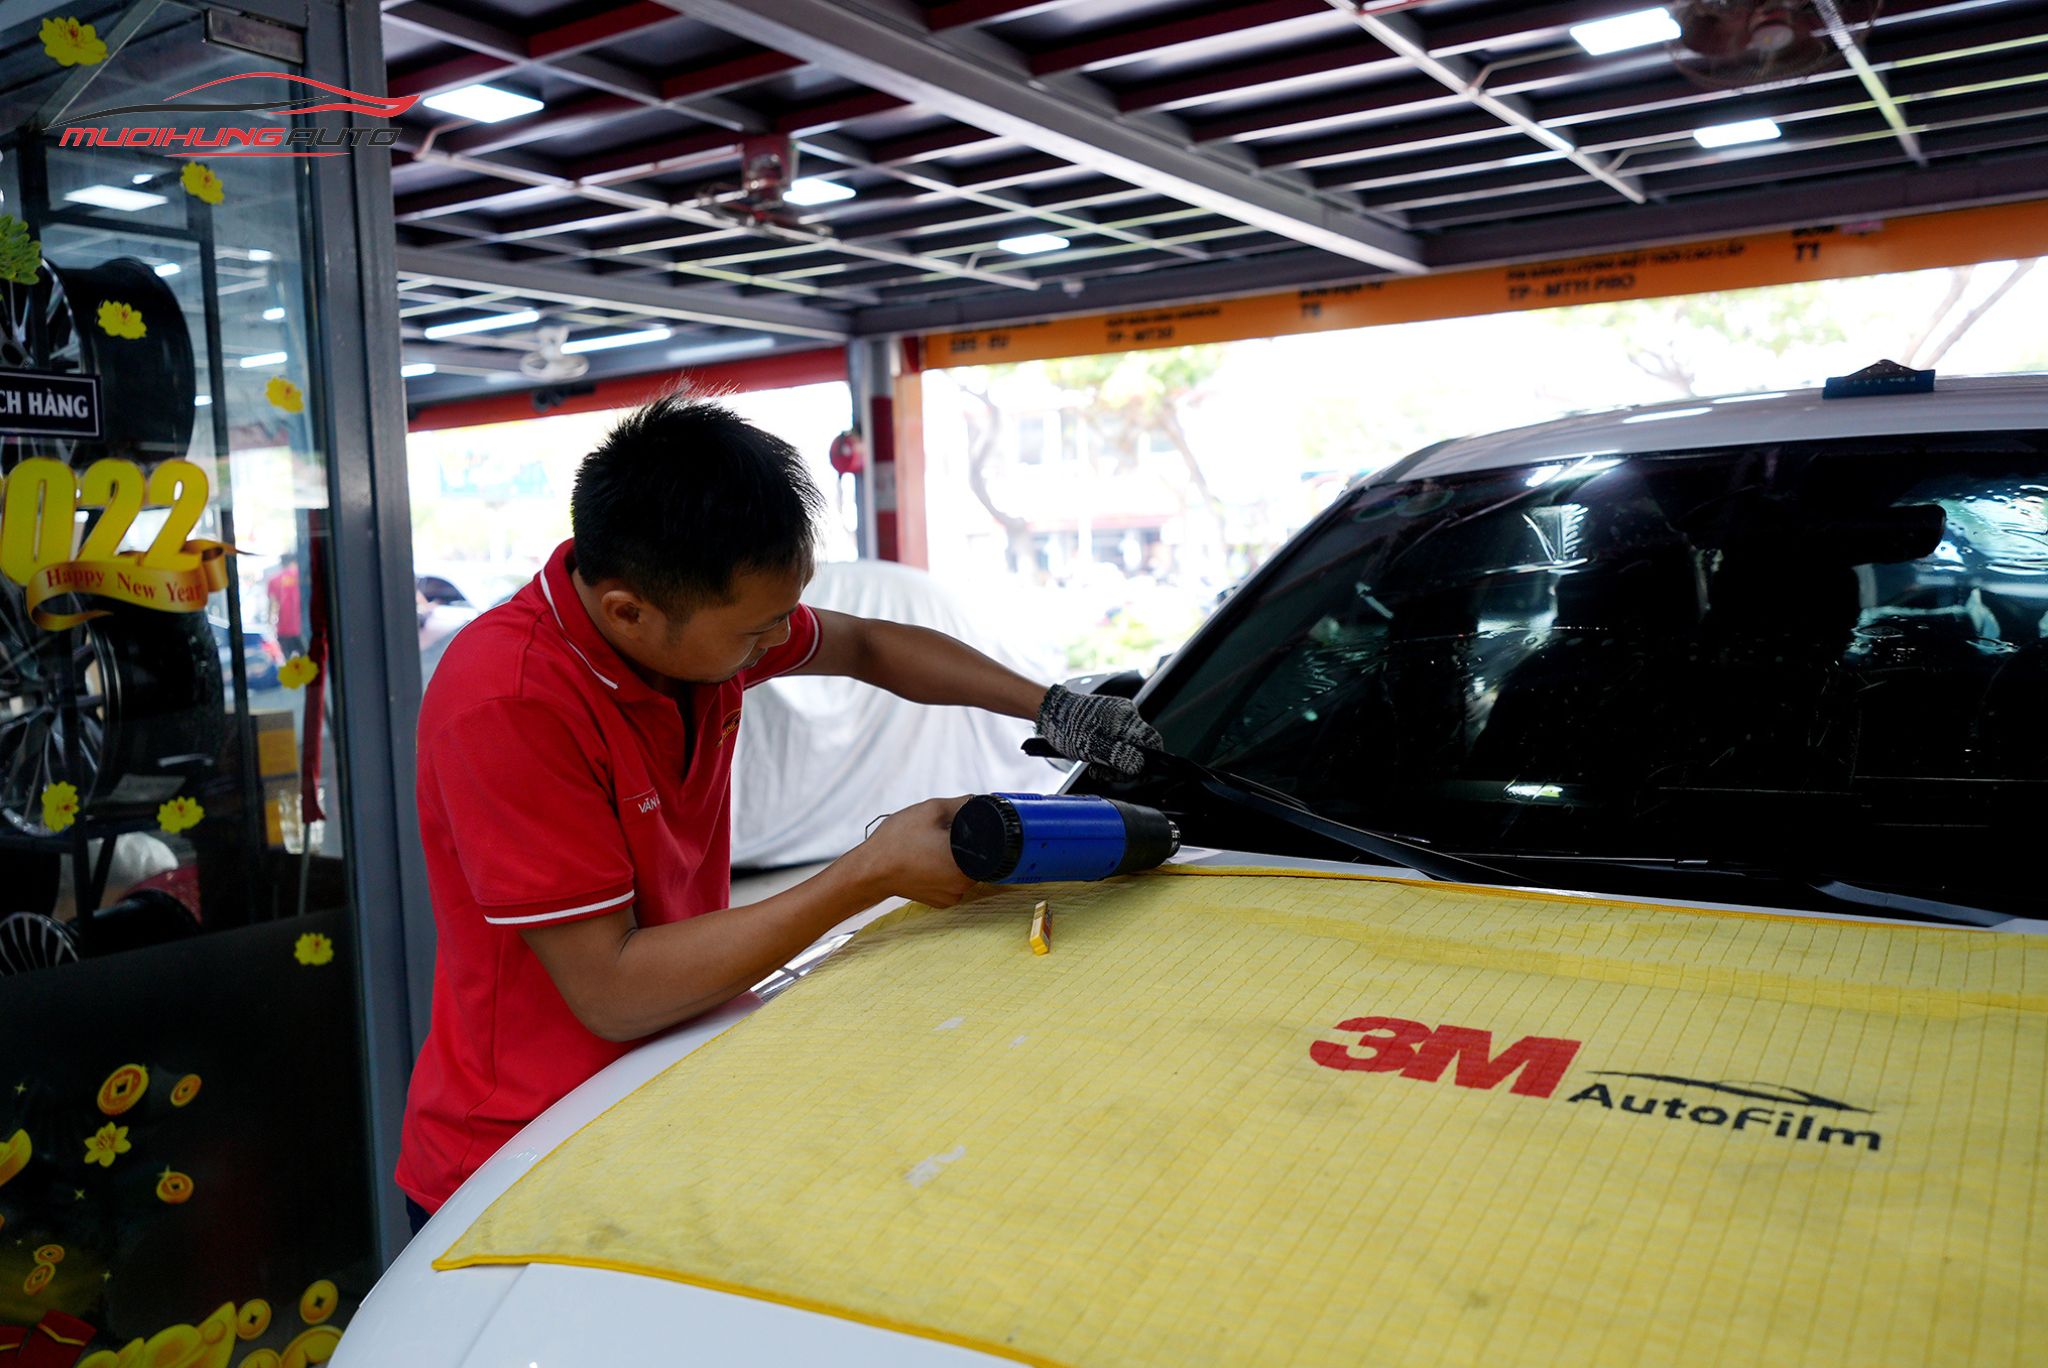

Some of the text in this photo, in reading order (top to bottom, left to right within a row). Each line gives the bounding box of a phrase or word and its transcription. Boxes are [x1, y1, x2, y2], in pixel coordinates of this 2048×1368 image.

[27, 387, 89, 419] HÀNG
[0, 456, 209, 588] 022
[46, 566, 204, 604] Happy New Year
[1309, 1016, 1582, 1099] 3M
[1567, 1082, 1882, 1152] AutoFilm
